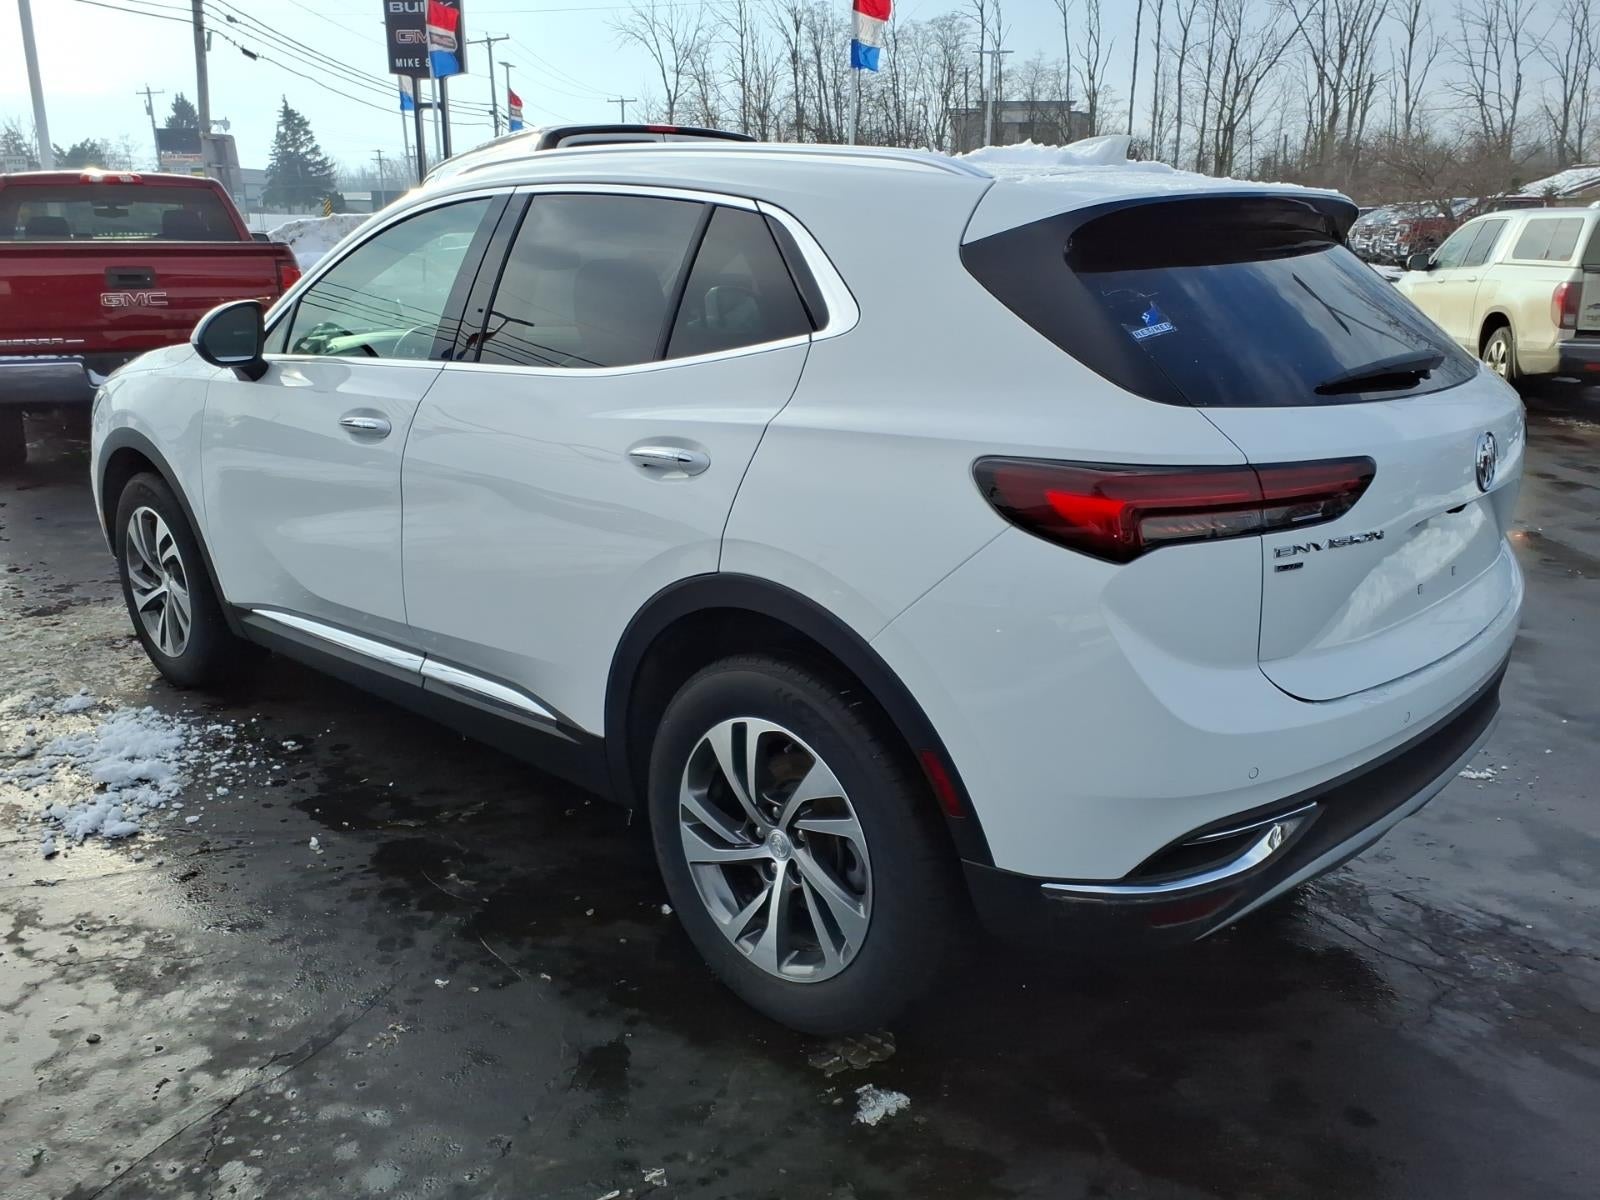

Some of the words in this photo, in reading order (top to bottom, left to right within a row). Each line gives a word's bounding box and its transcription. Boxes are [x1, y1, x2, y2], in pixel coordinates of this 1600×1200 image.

[395, 58, 420, 68] MIKE
[100, 292, 169, 307] GMC
[1273, 529, 1385, 559] ENVISION
